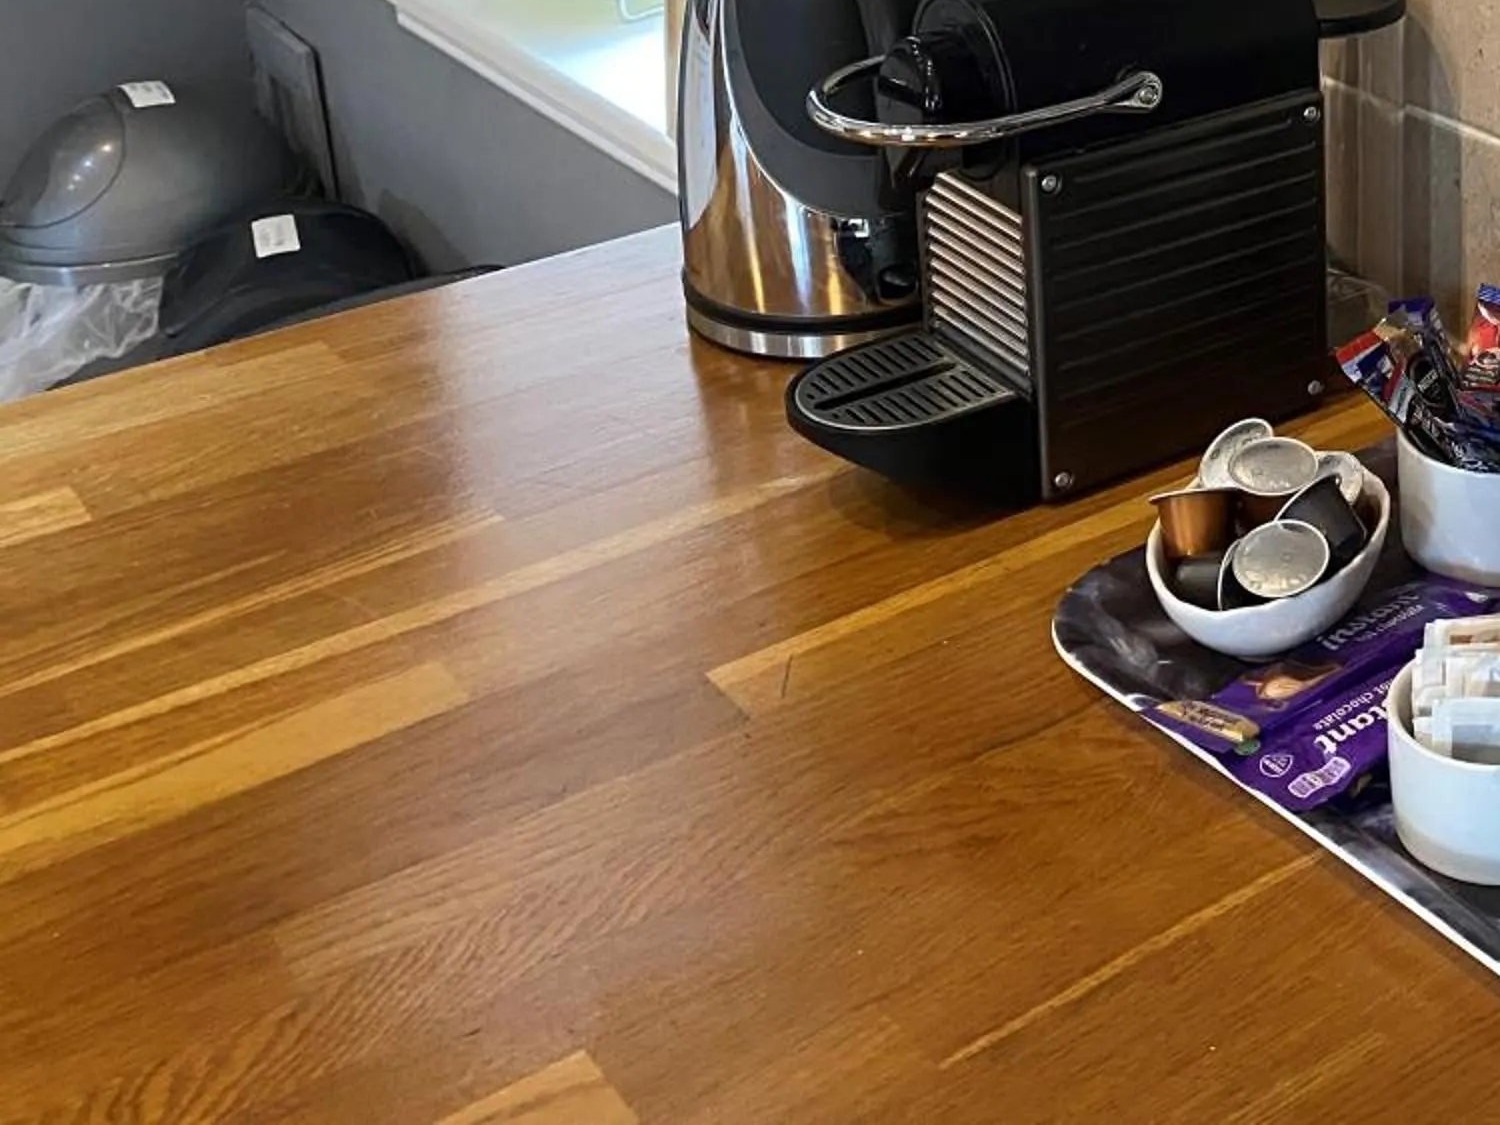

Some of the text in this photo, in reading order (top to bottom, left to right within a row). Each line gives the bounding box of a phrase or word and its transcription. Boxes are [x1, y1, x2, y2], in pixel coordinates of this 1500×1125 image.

[1316, 595, 1419, 651] instant
[1312, 691, 1374, 730] chocolate
[1314, 702, 1389, 755] tant
